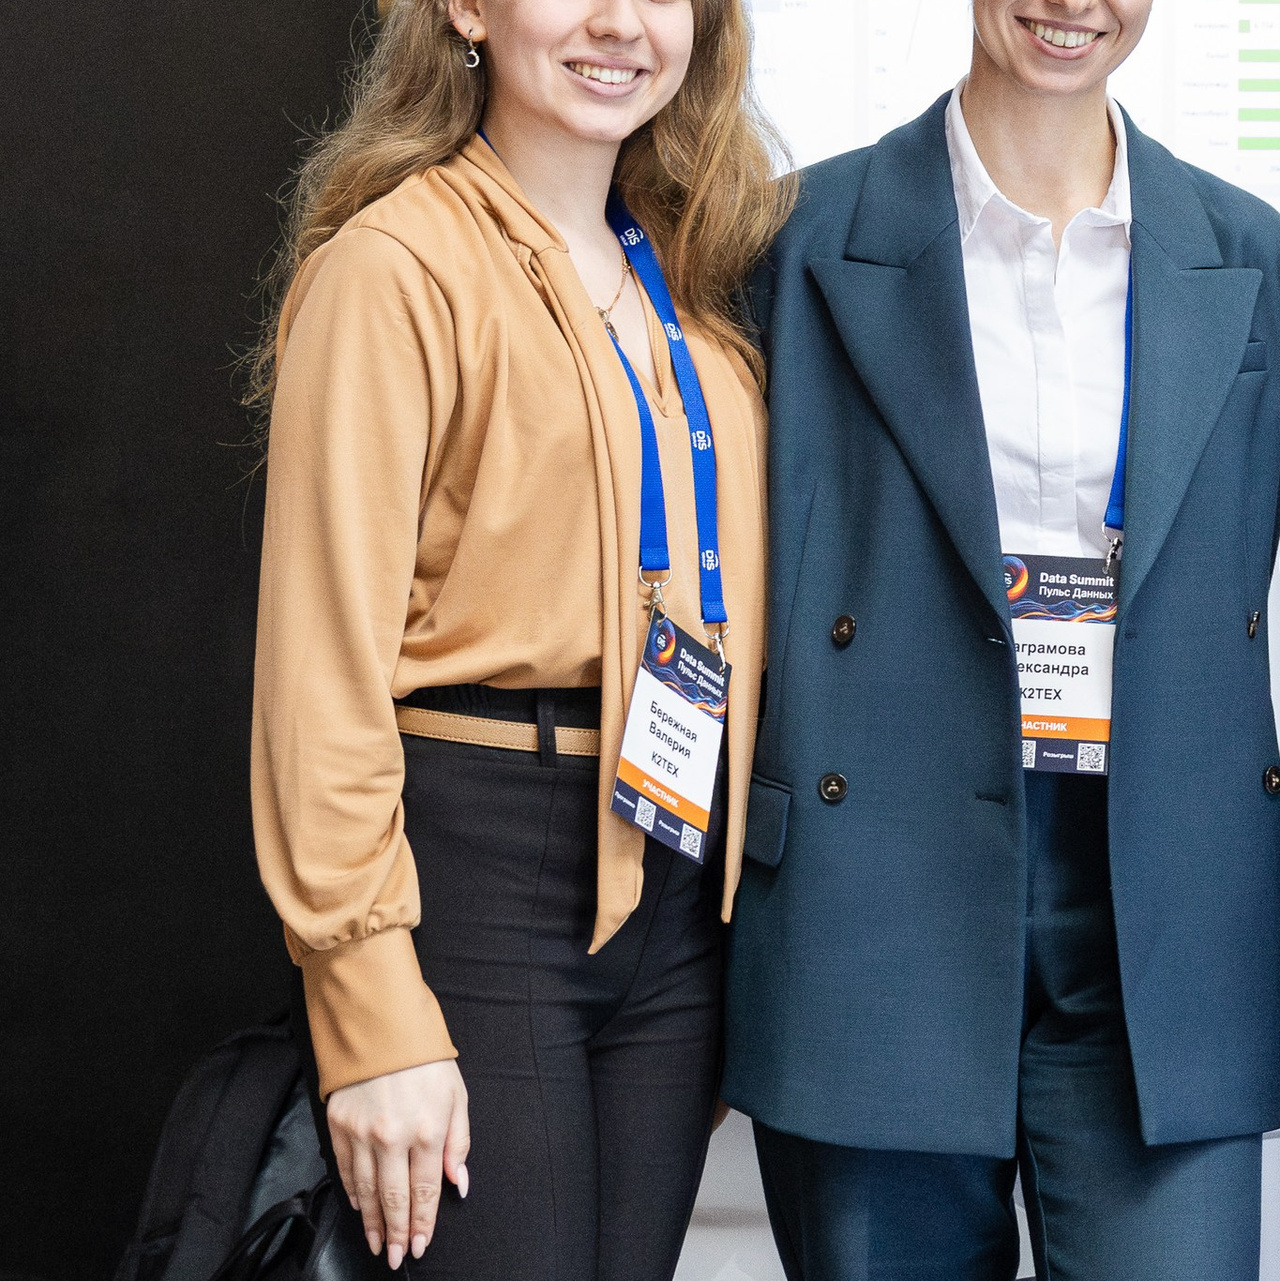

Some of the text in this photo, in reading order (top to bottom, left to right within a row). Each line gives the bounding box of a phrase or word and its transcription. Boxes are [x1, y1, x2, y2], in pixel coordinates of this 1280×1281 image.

[1040, 572, 1115, 587] Data Summit
[1039, 586, 1114, 600] Пульс Данных
[1014, 642, 1086, 656] аграмова
[680, 648, 725, 686] Data Summit
[1018, 663, 1089, 678] ександра
[678, 660, 723, 698] Пульс Данных
[650, 700, 698, 743] Бережная
[1021, 721, 1068, 732] ЧАСТНИК
[649, 721, 691, 759] Валерия
[642, 778, 680, 808] УЧАСТНИК
